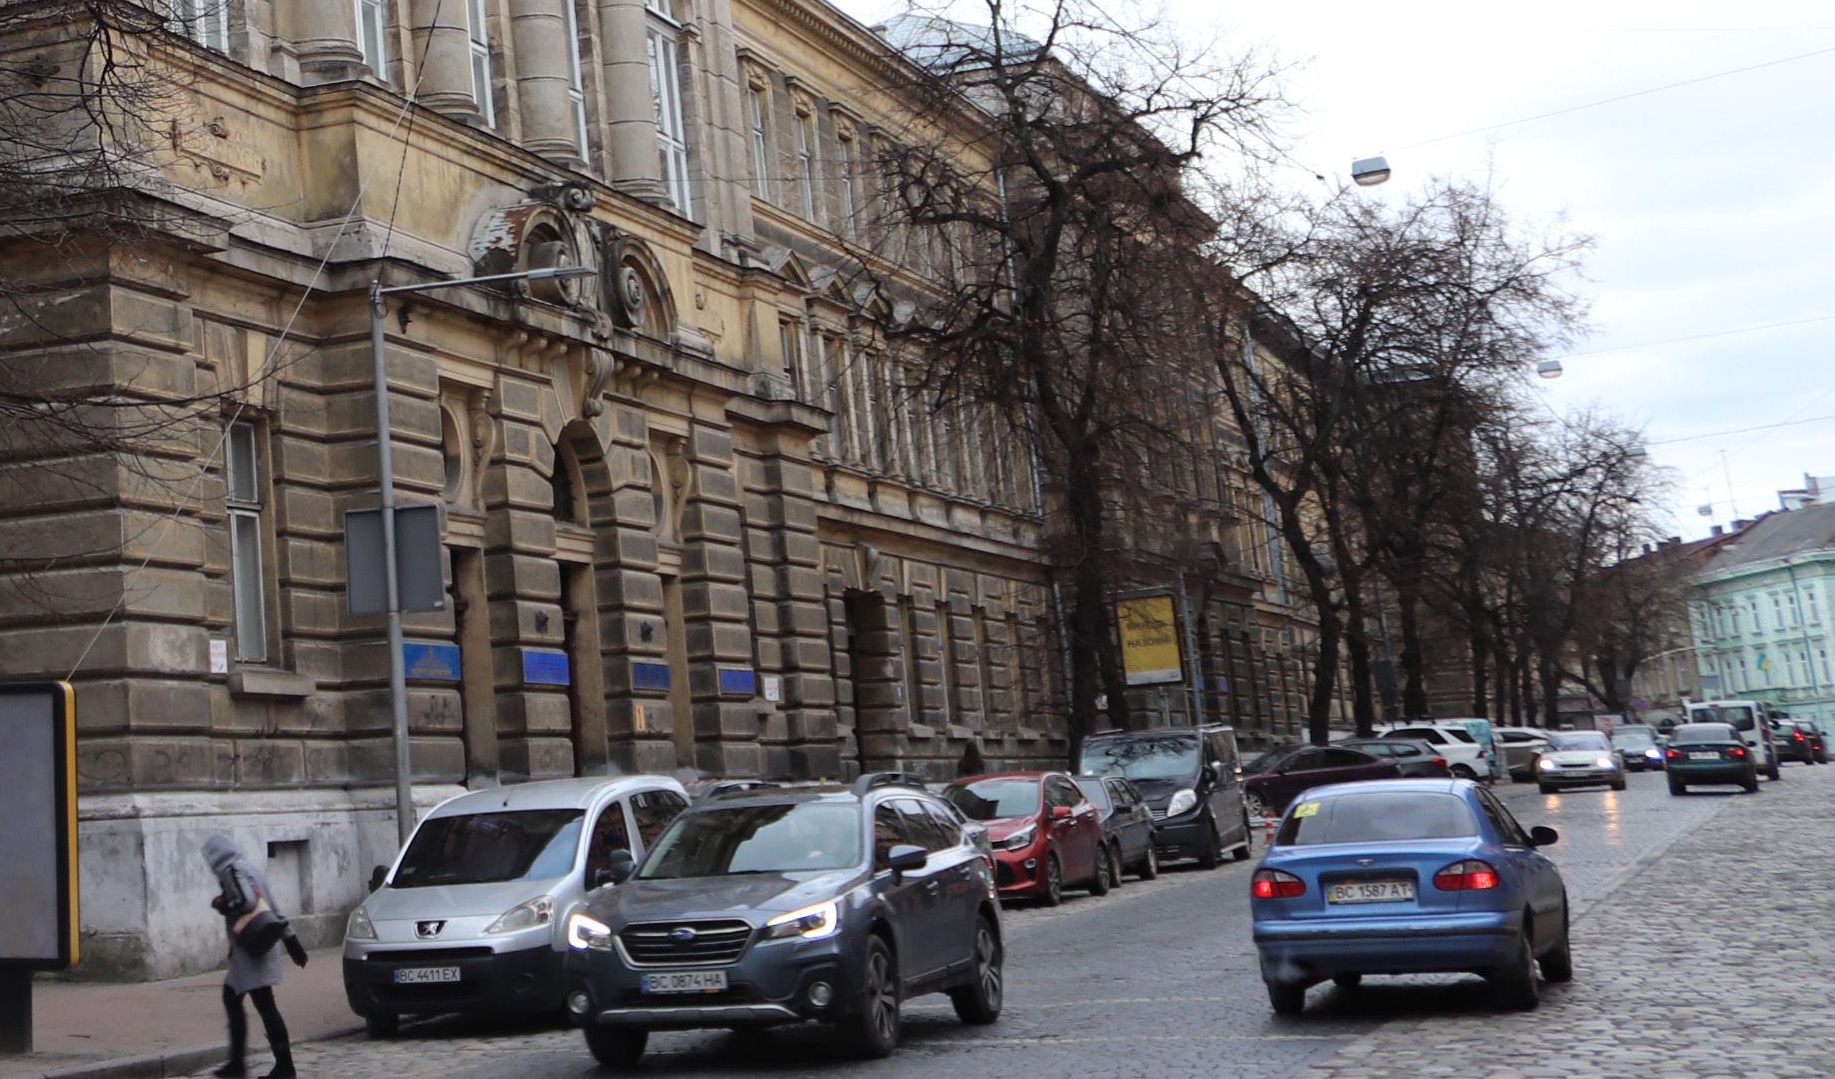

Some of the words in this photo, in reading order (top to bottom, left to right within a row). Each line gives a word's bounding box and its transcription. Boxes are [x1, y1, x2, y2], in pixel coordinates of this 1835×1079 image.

[1335, 886, 1354, 899] BC
[1358, 884, 1386, 898] 1587
[1391, 884, 1408, 897] AT
[400, 970, 415, 982] BC
[417, 969, 441, 981] 4411
[442, 968, 458, 980] EX
[649, 975, 668, 989] BC
